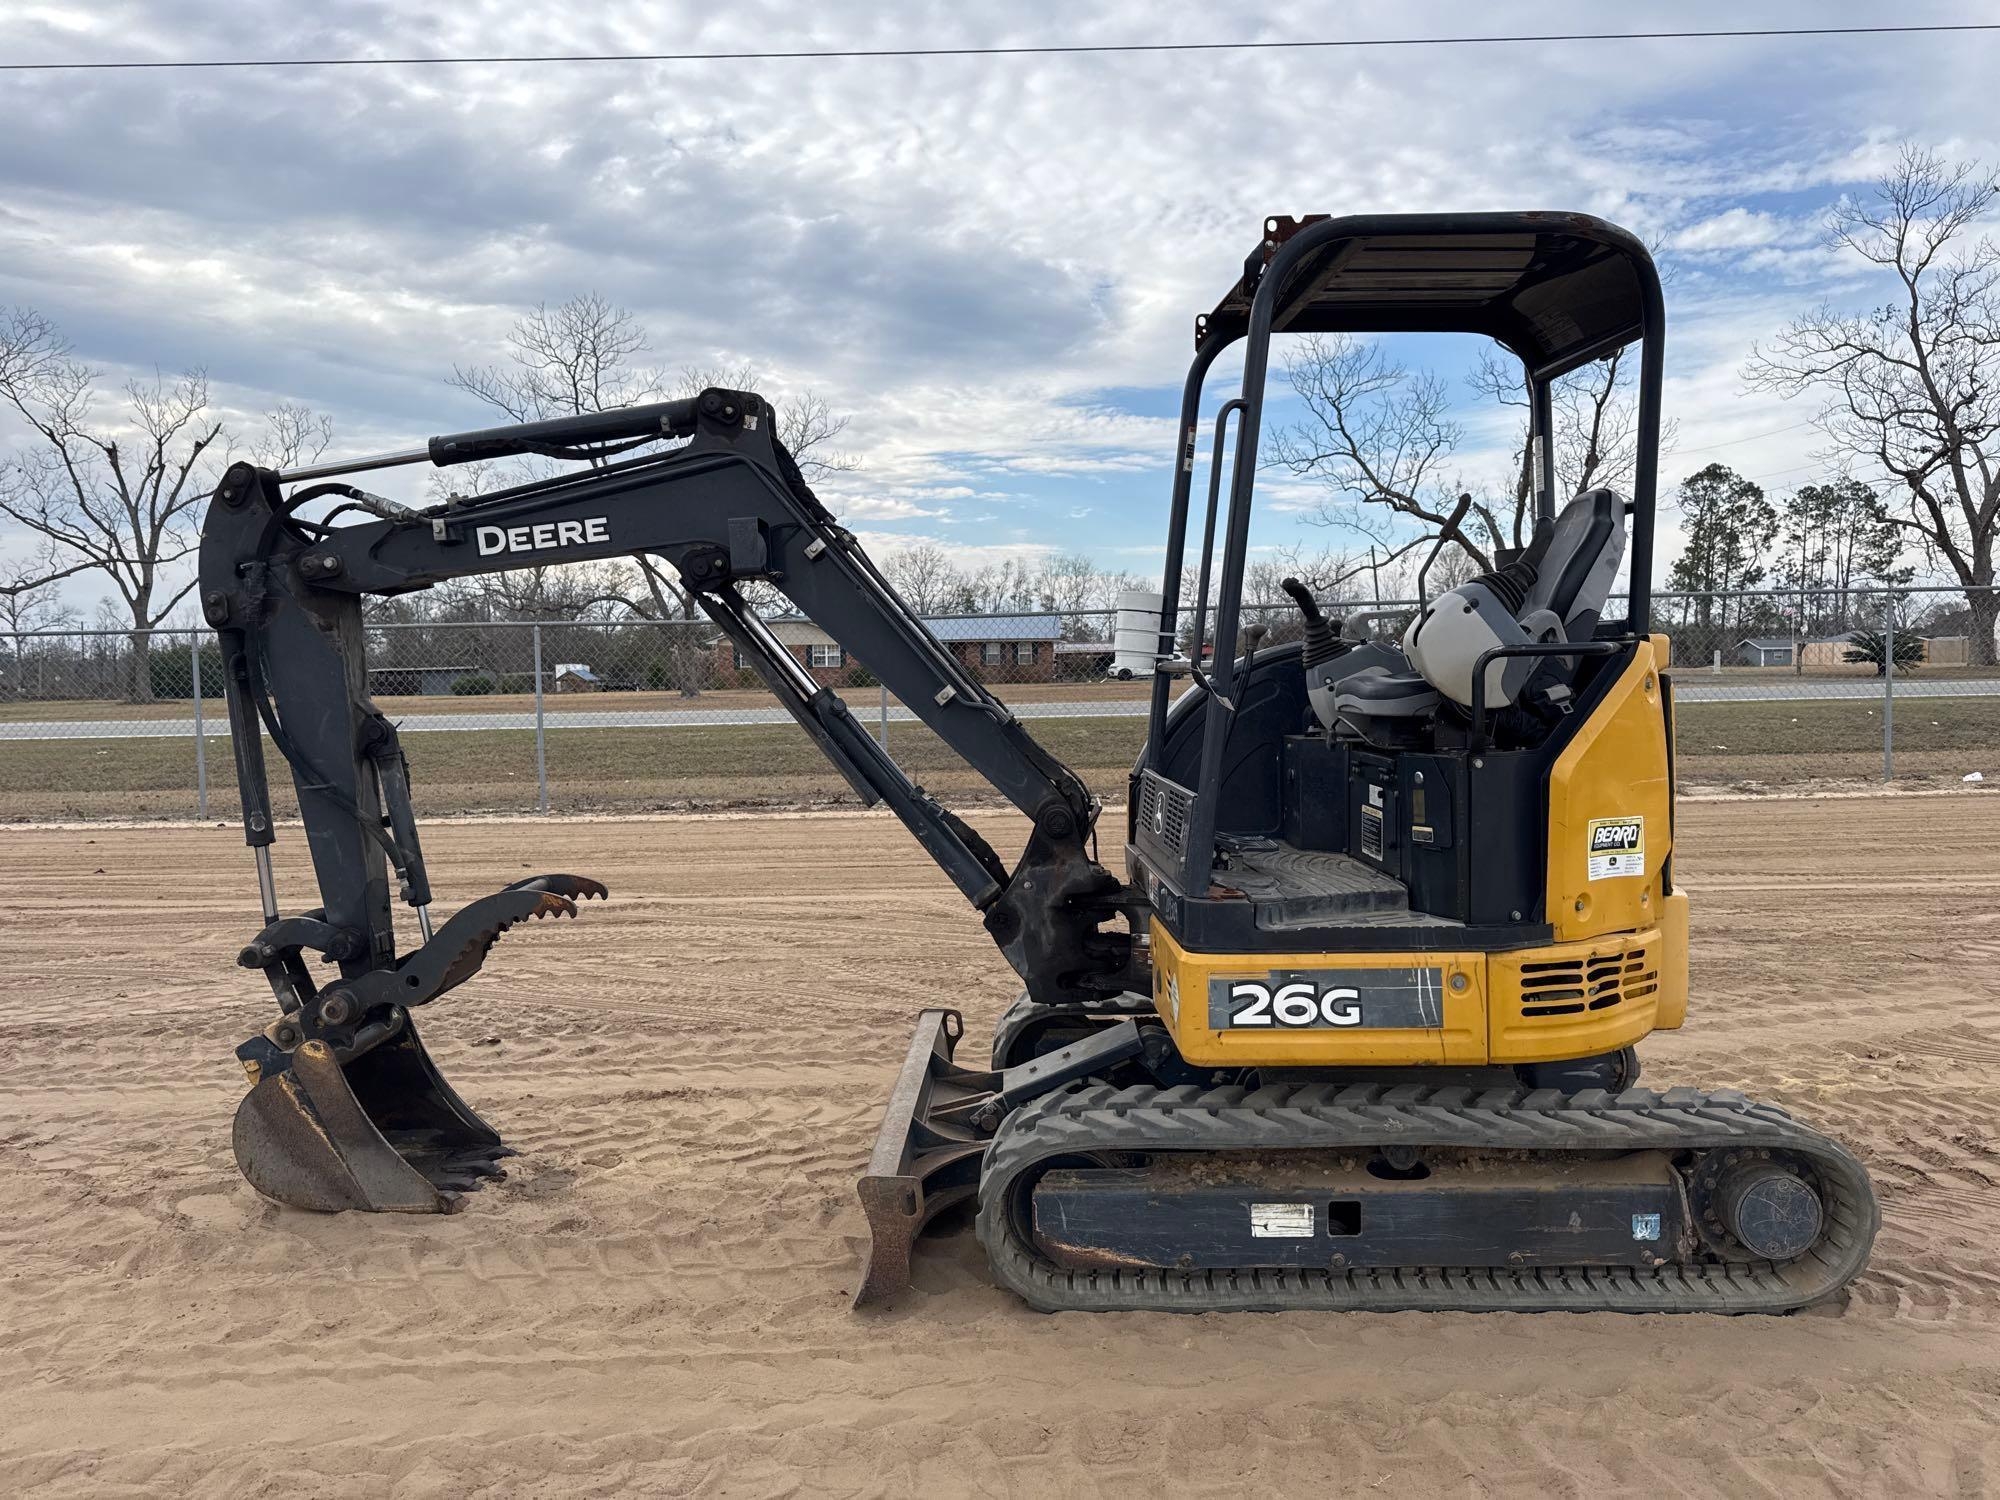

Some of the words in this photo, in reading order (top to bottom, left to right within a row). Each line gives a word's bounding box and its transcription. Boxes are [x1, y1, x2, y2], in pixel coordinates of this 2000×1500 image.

[476, 517, 610, 556] DEERE
[1594, 826, 1637, 848] BEARD
[1231, 982, 1361, 1027] 26G
